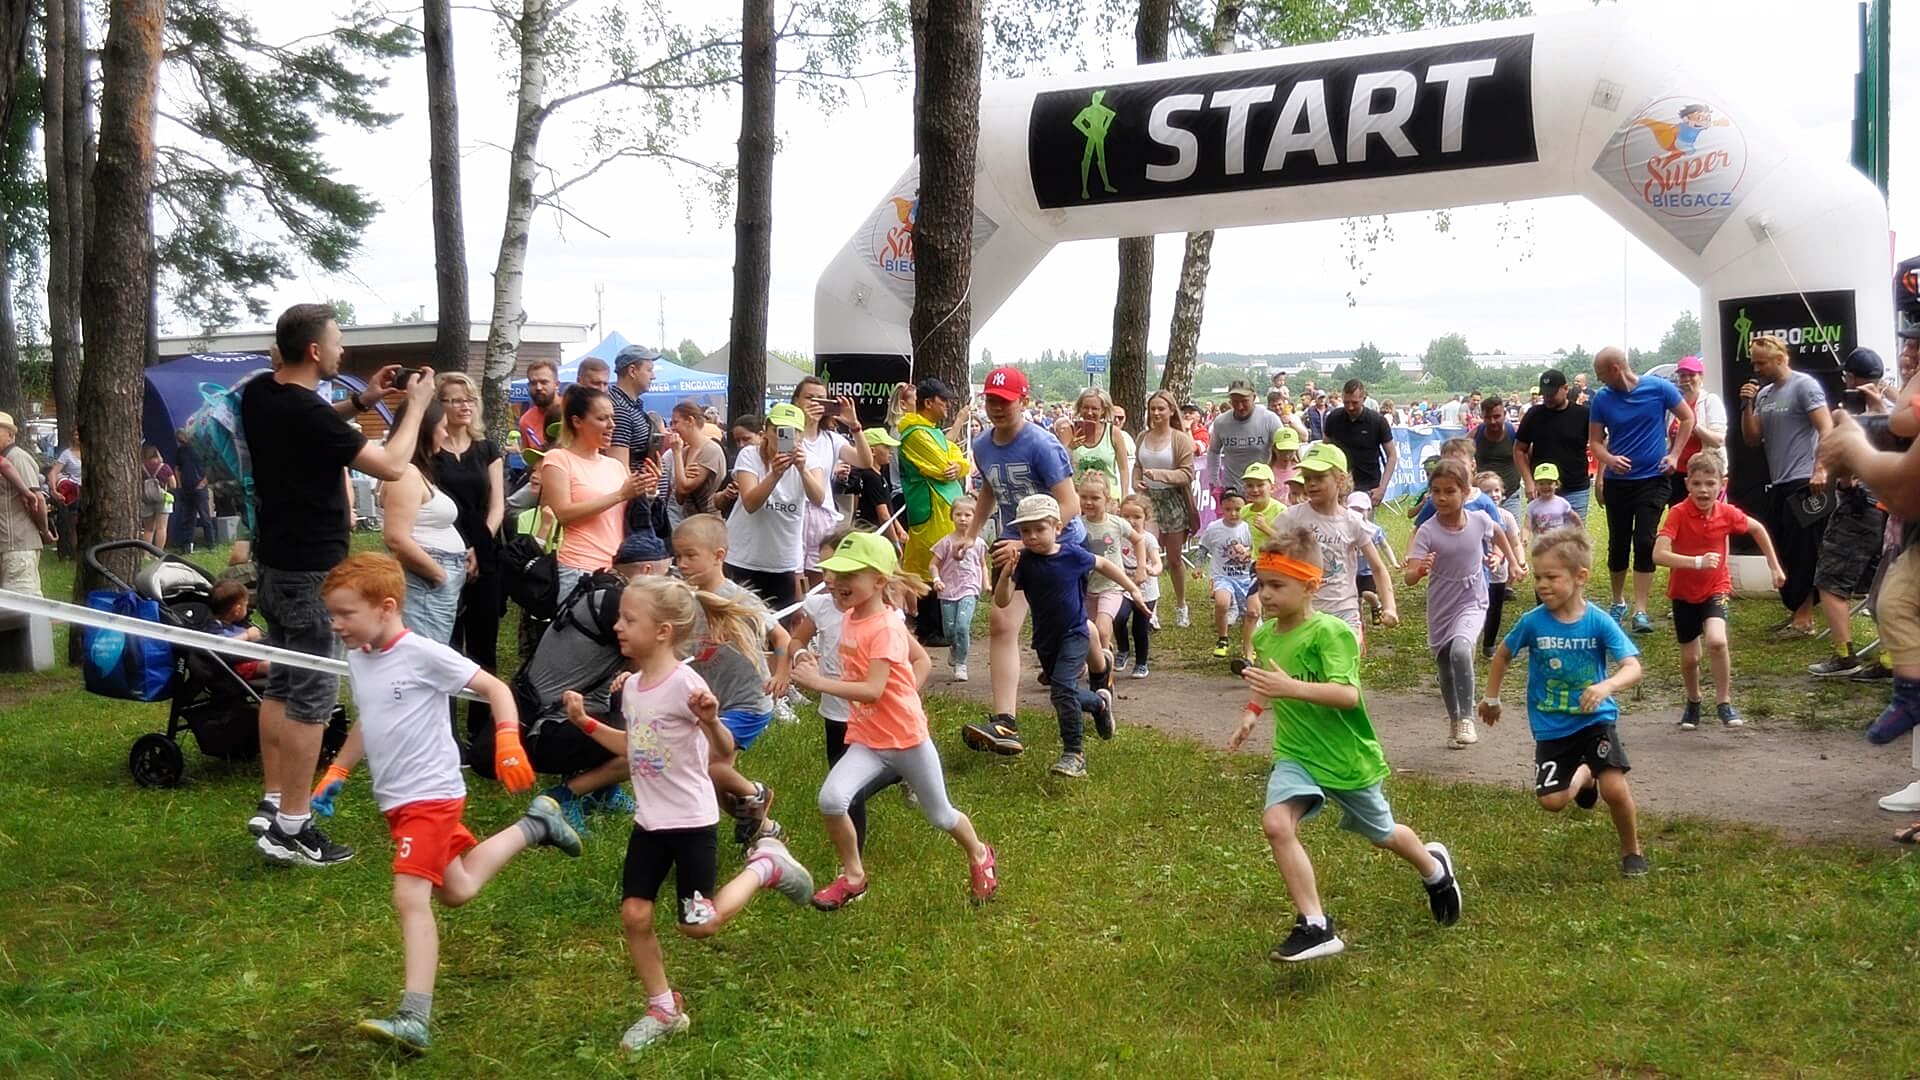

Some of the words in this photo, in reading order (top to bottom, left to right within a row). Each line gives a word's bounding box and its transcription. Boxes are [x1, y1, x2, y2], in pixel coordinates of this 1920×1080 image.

[1145, 58, 1496, 182] START
[1644, 150, 1732, 204] Super
[1653, 192, 1732, 208] BIEGACZ
[1799, 343, 1840, 353] KIDS
[680, 380, 725, 391] ENGRAVING
[987, 463, 1035, 504] 45
[766, 501, 797, 513] HERO
[1551, 637, 1597, 649] SEATTLE
[393, 687, 402, 700] 5
[400, 837, 413, 858] 5
